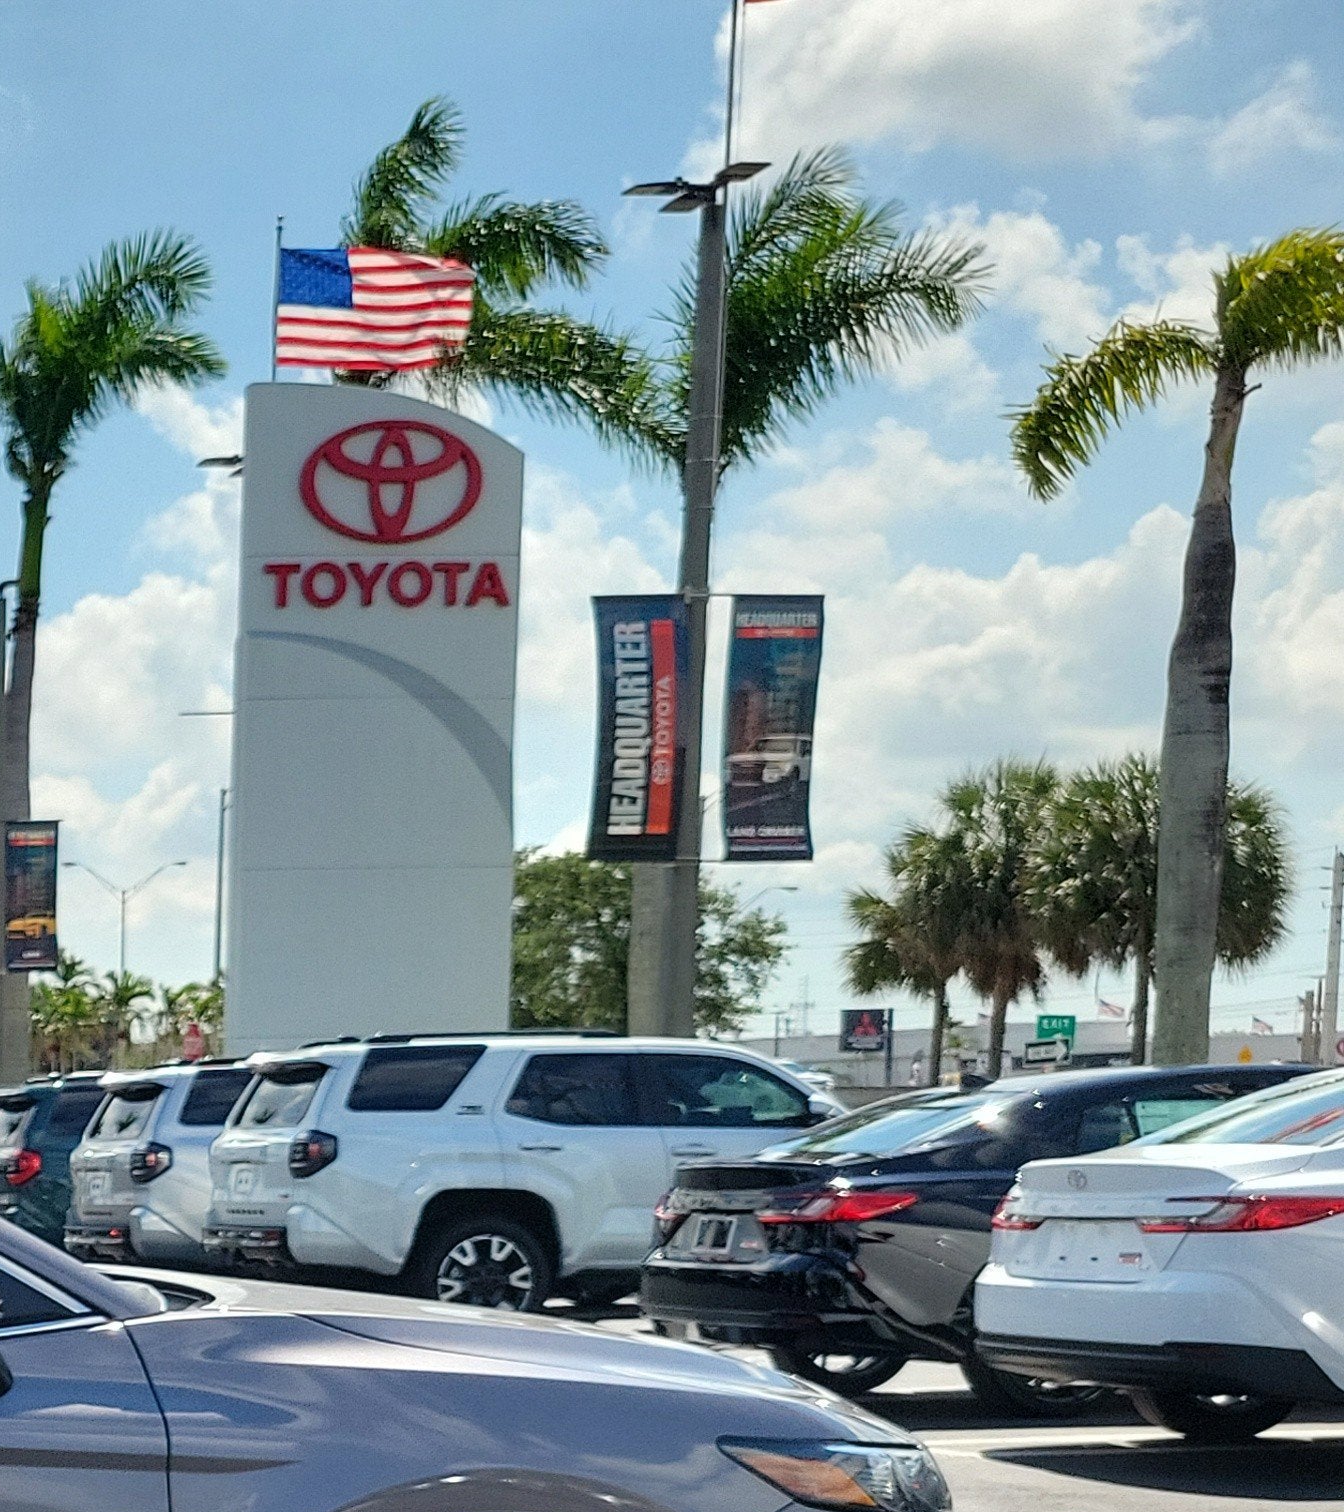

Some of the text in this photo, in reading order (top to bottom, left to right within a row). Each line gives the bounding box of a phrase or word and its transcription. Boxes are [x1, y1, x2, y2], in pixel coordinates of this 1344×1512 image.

[264, 561, 510, 609] TOYOTA
[607, 621, 651, 835] HEADQUARTER
[654, 675, 675, 755] TOYOTA
